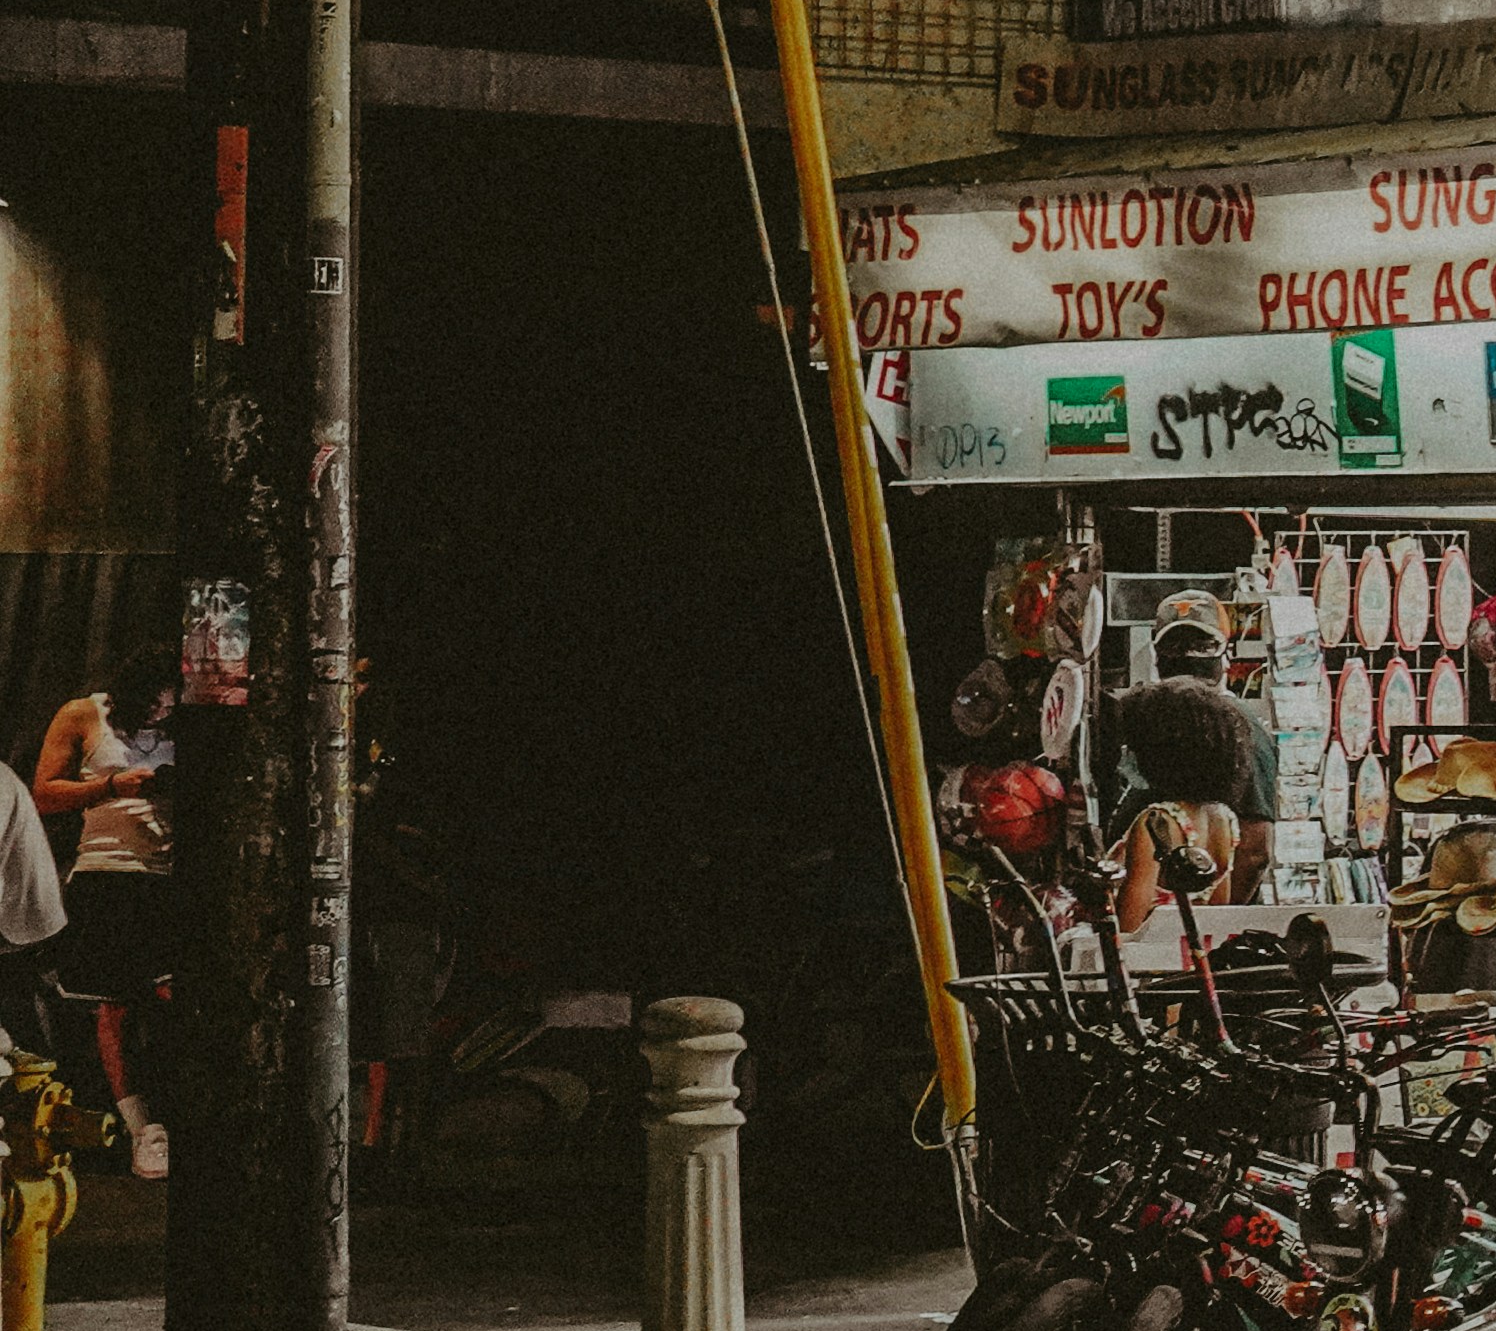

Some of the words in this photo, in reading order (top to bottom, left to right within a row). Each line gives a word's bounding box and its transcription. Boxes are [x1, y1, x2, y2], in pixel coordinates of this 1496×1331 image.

[842, 204, 919, 263] ATS
[1011, 182, 1255, 253] SUNLOTION
[1051, 279, 1168, 340] TOY'S
[1258, 265, 1410, 330] PHONE
[1049, 398, 1117, 430] Newport
